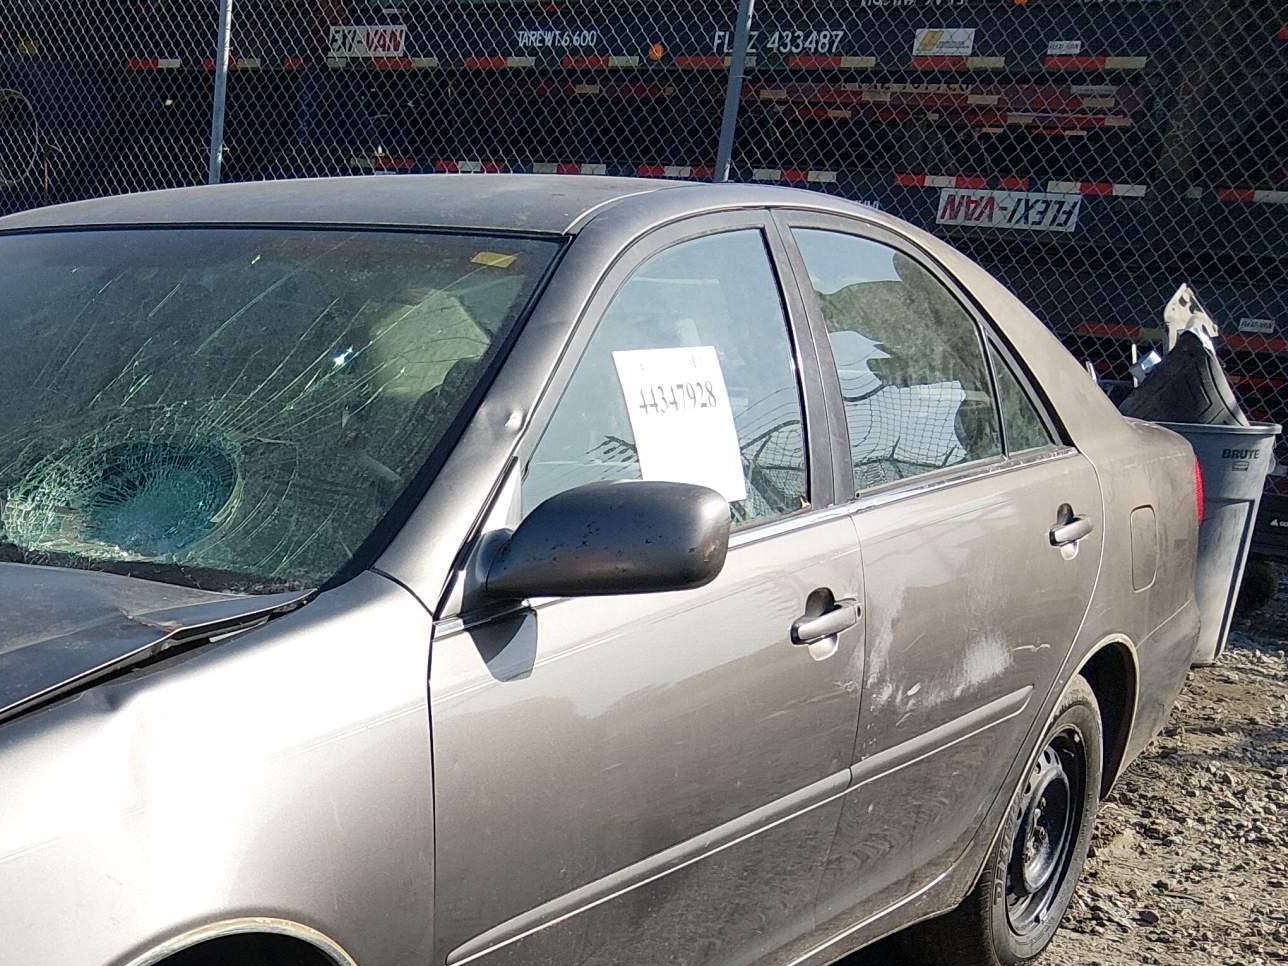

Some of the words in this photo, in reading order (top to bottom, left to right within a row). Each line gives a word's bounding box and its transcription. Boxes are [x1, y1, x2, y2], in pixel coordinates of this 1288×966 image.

[713, 31, 759, 53] FLZ
[766, 30, 845, 53] 433487
[940, 194, 1079, 228] FLEXI-VAN
[639, 381, 717, 414] 44347928
[1222, 448, 1260, 459] BRUTE
